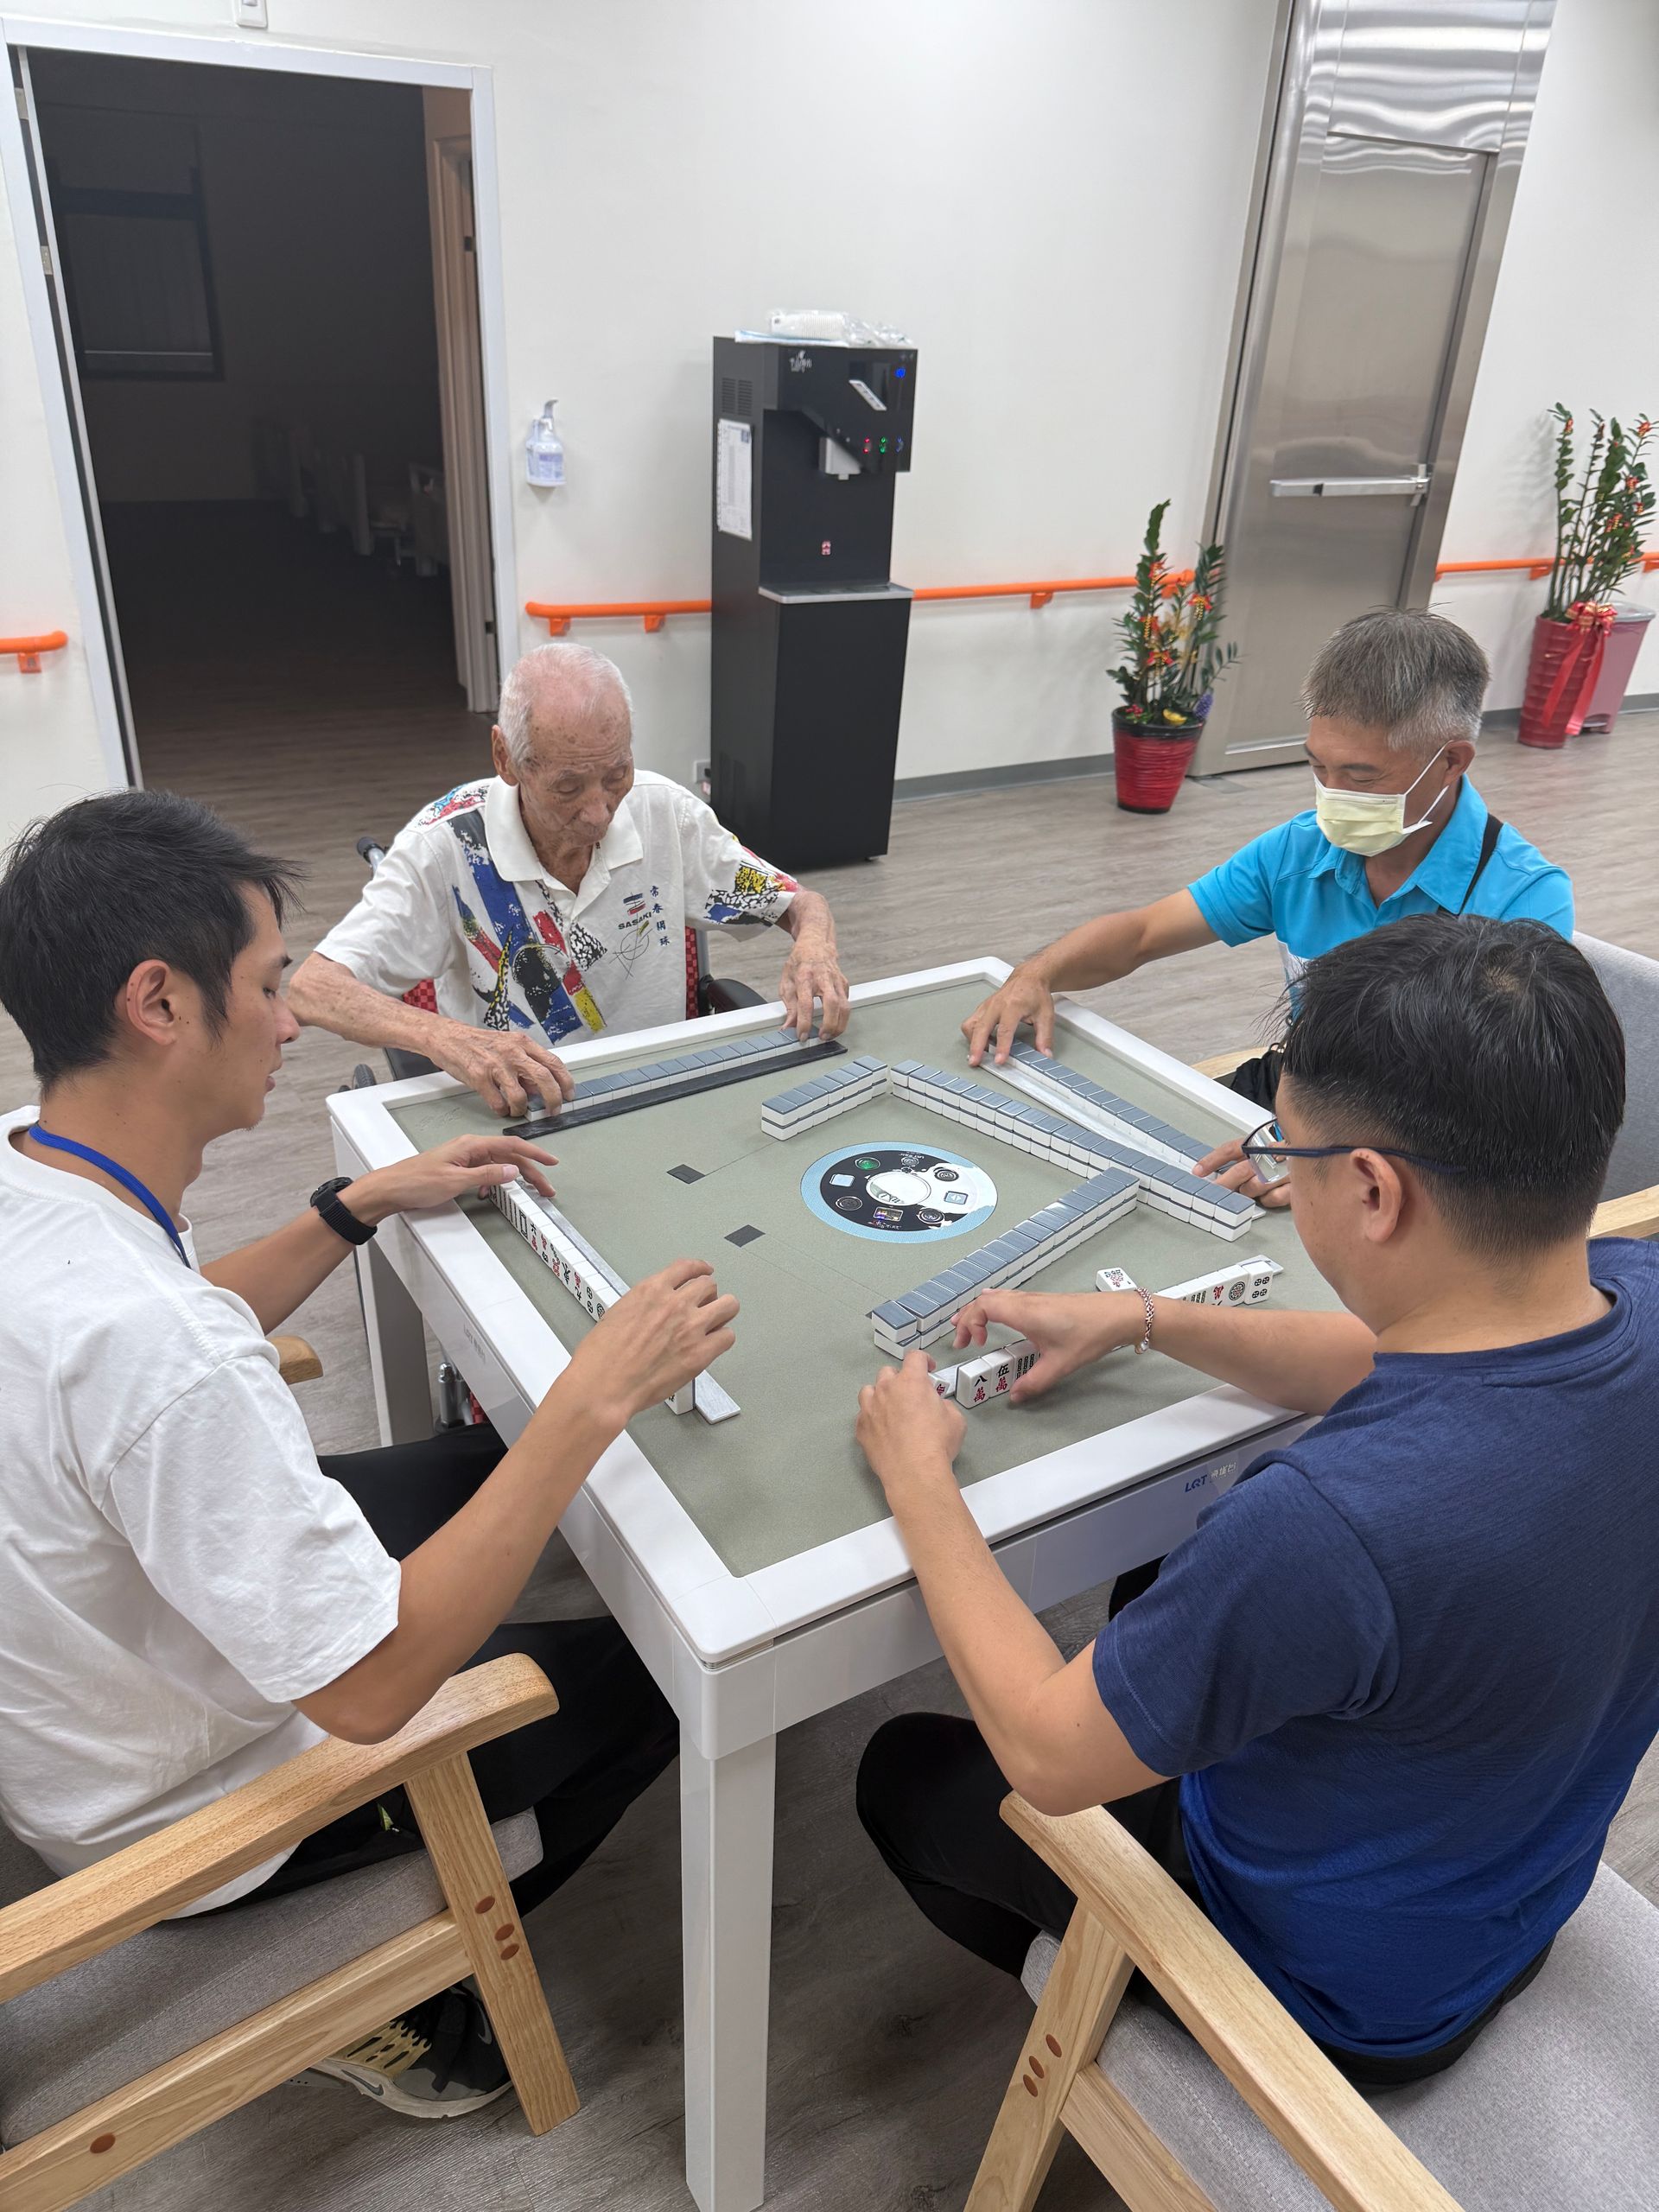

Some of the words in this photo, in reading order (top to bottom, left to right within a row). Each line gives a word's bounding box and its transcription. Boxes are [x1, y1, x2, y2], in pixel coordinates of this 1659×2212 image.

[618, 912, 652, 930] SASAKI
[974, 1375, 988, 1402] 八萬
[995, 1363, 1010, 1392] 伍萬
